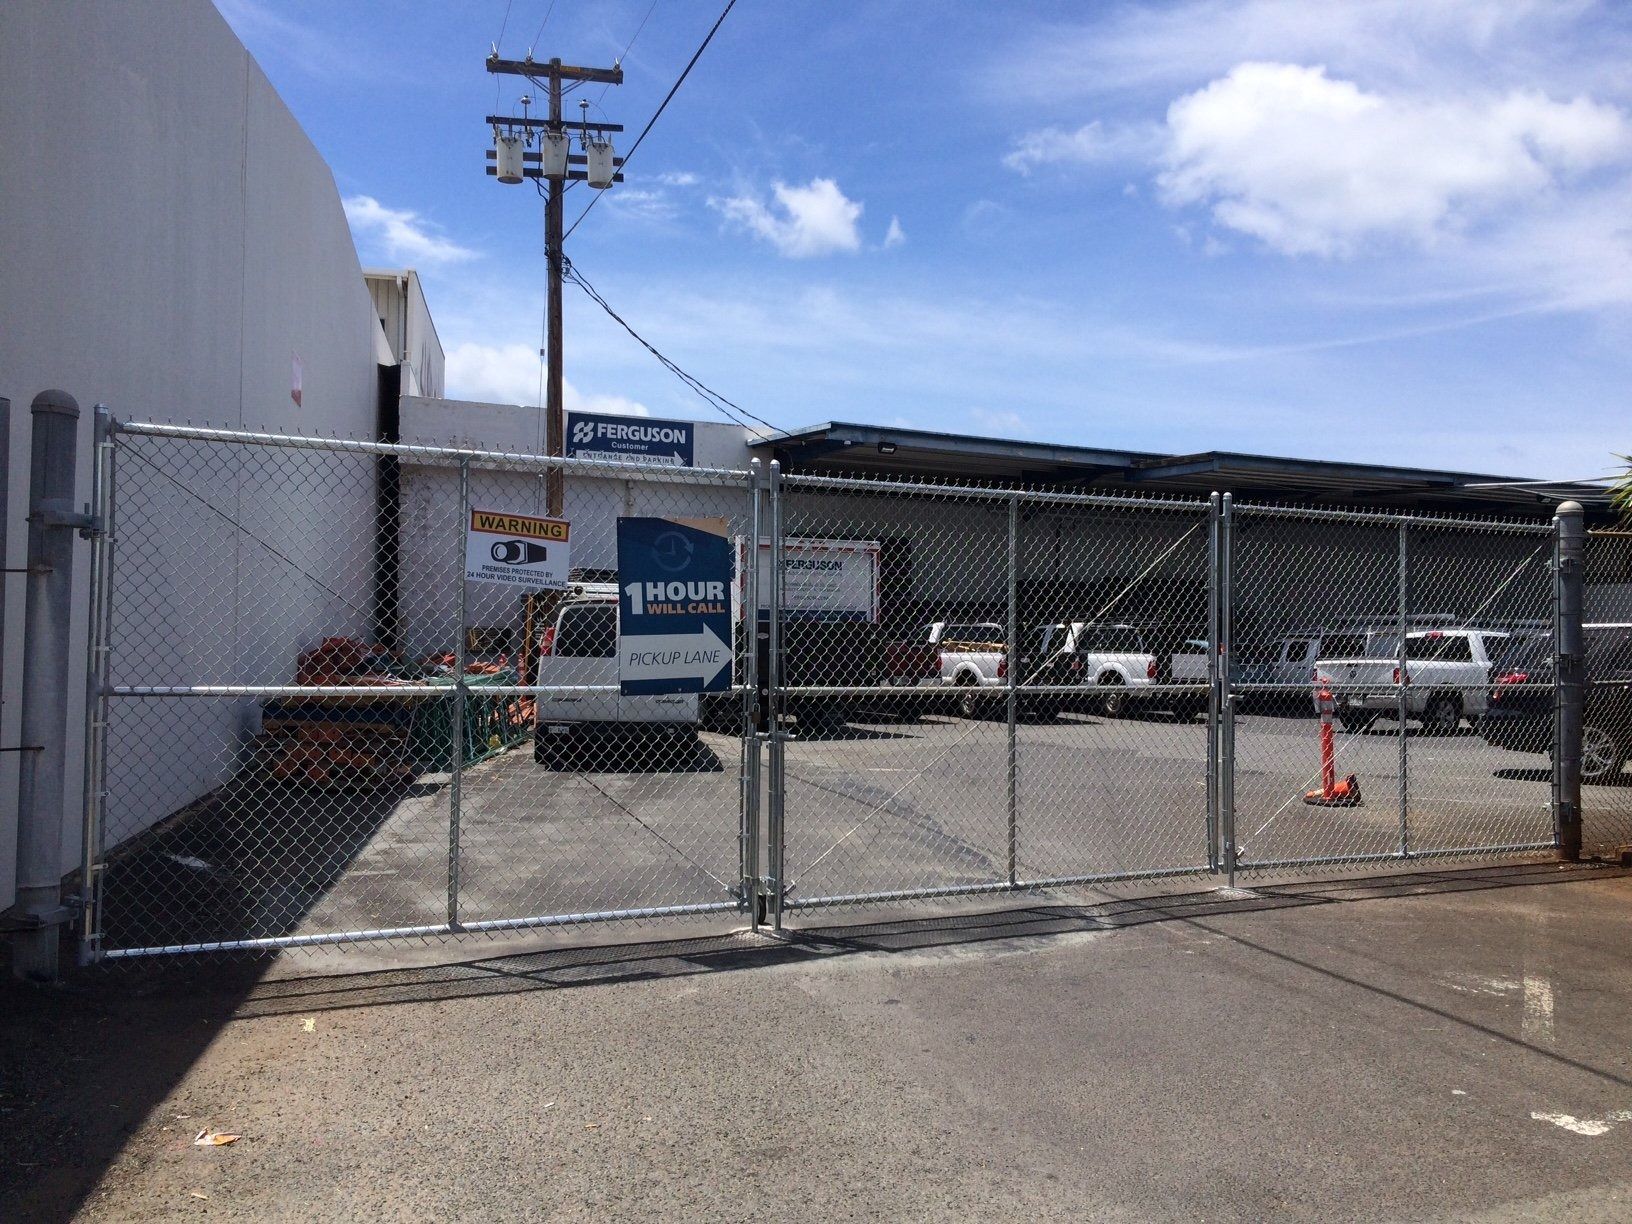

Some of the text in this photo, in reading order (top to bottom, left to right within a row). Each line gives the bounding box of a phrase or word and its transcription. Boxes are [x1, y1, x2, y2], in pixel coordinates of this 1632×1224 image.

[597, 422, 686, 444] FERGUSON
[611, 441, 649, 451] Customer
[480, 515, 562, 537] WARNING
[482, 564, 511, 574] PREMISES
[511, 567, 544, 578] PROTECTED
[785, 559, 843, 571] FERGUSON
[476, 571, 496, 580] HOUR
[497, 574, 517, 582] VIDEO
[517, 576, 566, 588] SURVEILLANCE
[624, 581, 725, 615] 1 HOUR
[647, 602, 725, 614] WILL CALL
[629, 650, 721, 666] PICKUP LANE
